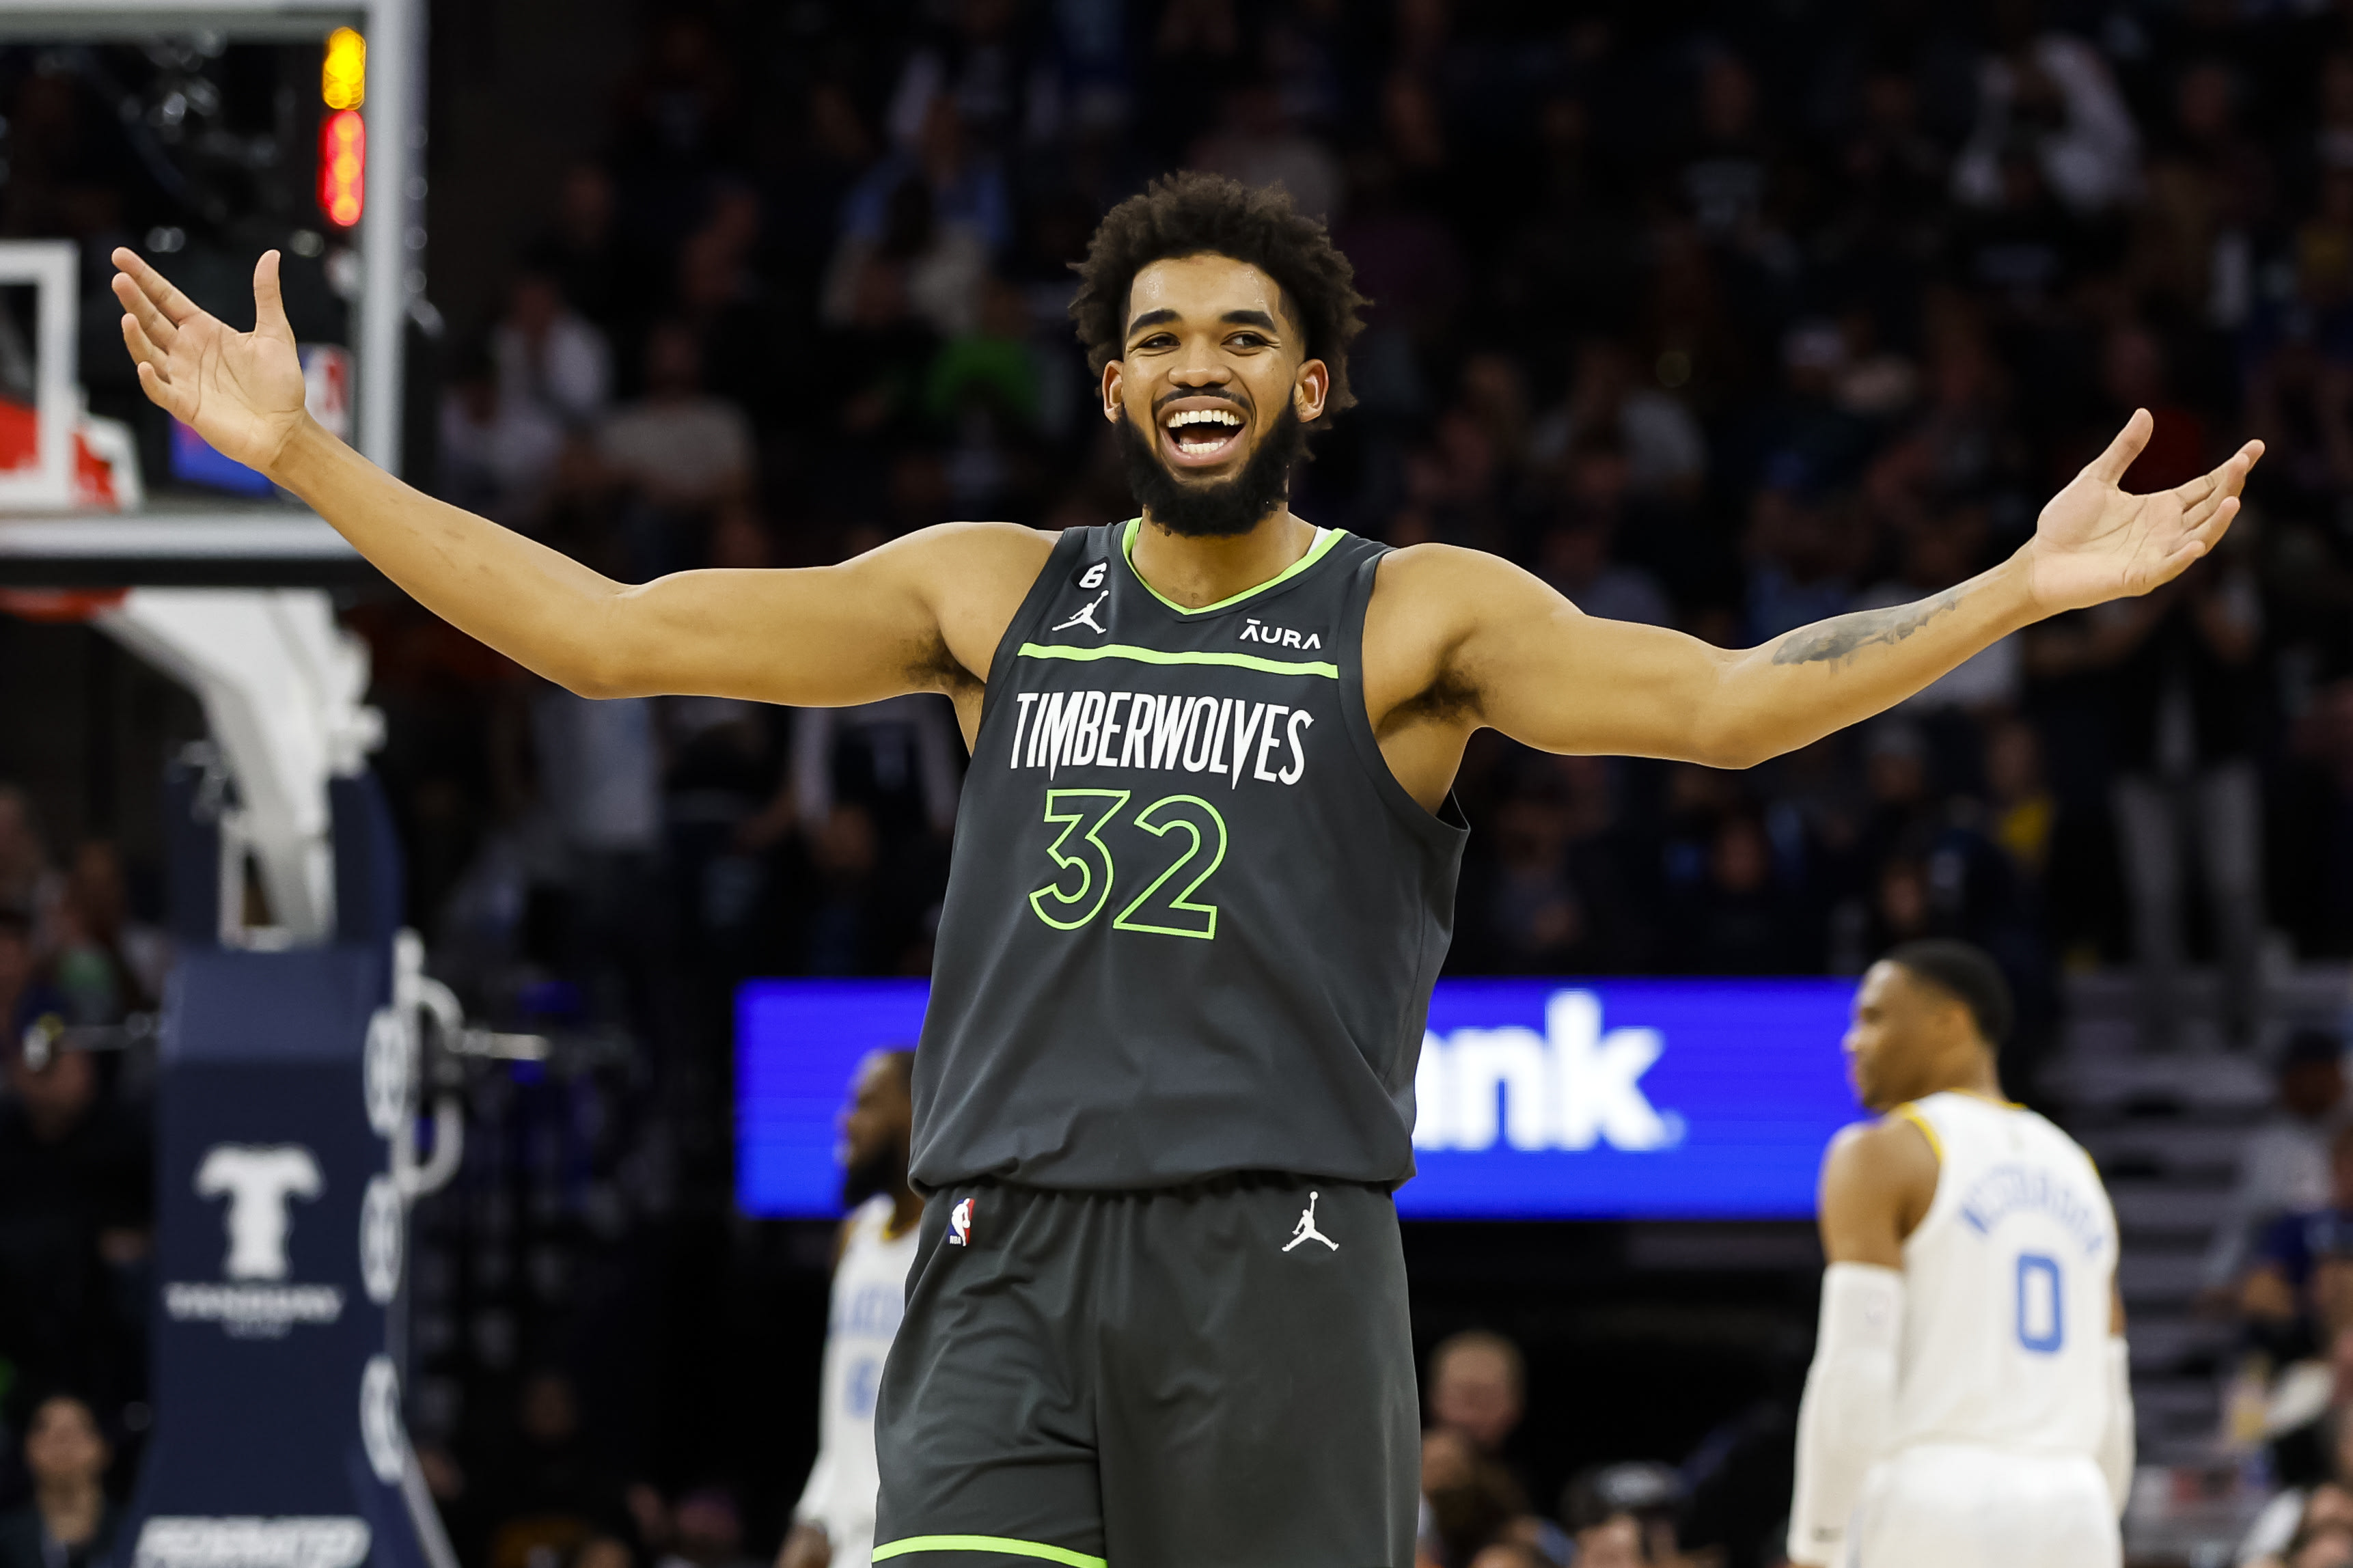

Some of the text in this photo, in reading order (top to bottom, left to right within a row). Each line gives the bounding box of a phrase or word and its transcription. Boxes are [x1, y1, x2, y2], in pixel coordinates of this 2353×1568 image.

[1079, 562, 1107, 589] 6
[1010, 691, 1314, 790] TIMBERWOLVES
[1029, 789, 1227, 940] 32
[949, 1235, 961, 1245] NBA
[2018, 1253, 2063, 1354] 0
